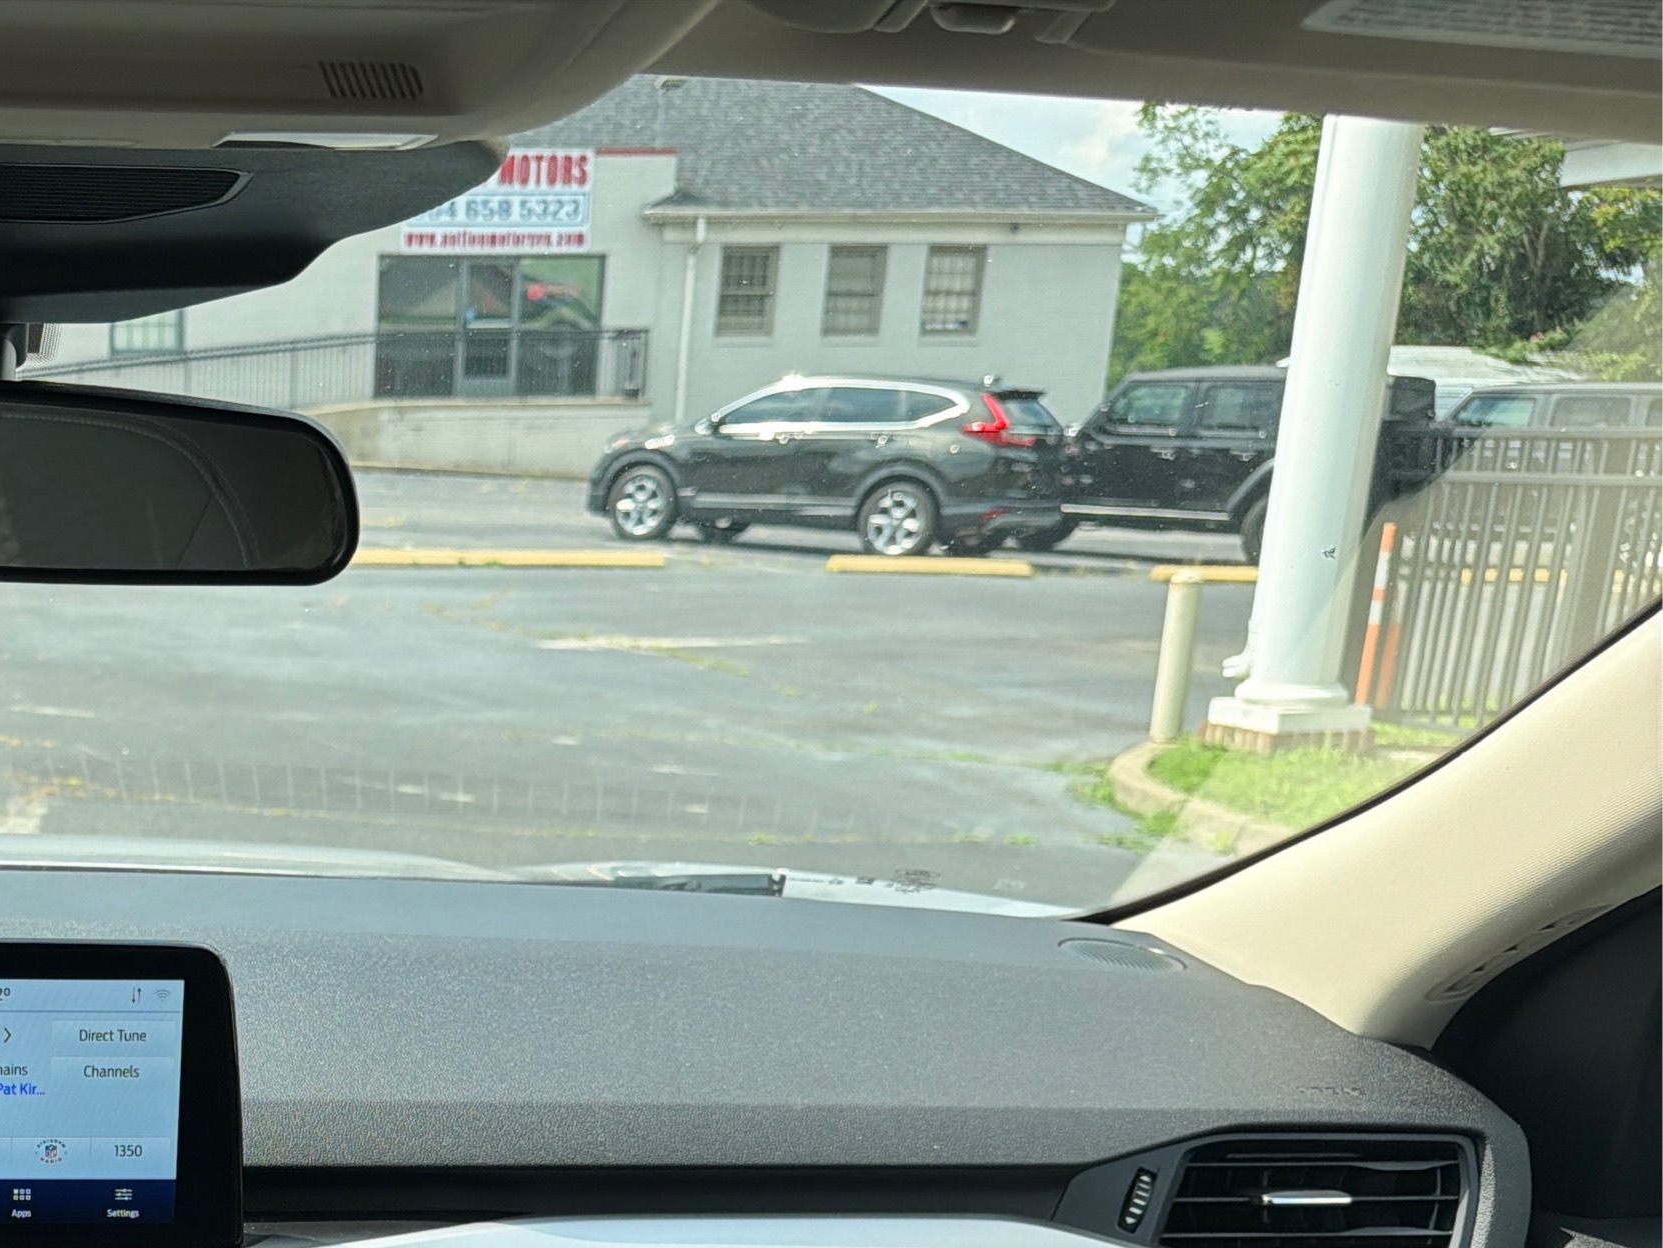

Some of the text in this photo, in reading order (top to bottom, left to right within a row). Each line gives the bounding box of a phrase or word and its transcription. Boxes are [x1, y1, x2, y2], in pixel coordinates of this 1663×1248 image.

[497, 154, 588, 186] MOTORS
[465, 199, 512, 223] 658
[519, 199, 581, 223] 5323
[79, 1029, 147, 1042] Direct Tune
[83, 1065, 140, 1078] Channels
[19, 1083, 46, 1096] Kir...
[114, 1144, 143, 1157] 1350
[11, 1208, 32, 1219] Apps
[106, 1208, 140, 1219] Settings
